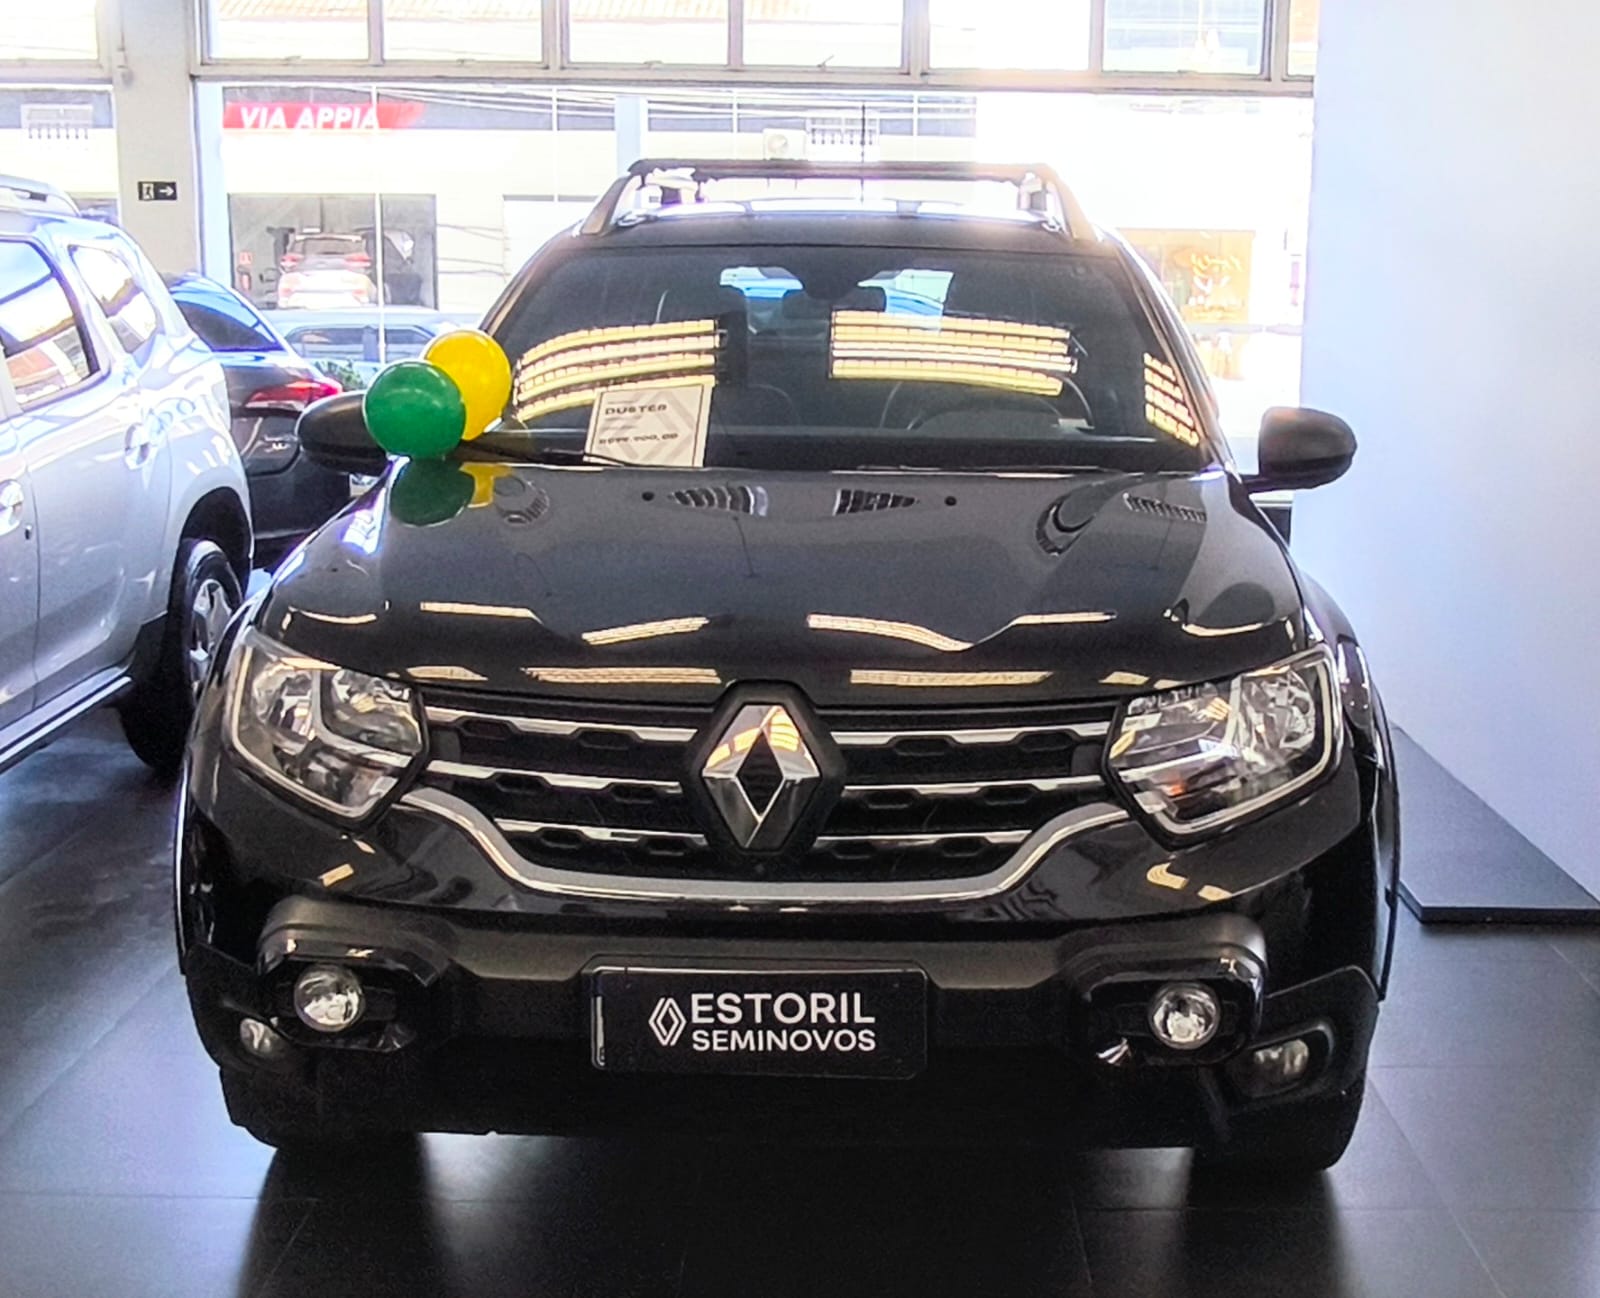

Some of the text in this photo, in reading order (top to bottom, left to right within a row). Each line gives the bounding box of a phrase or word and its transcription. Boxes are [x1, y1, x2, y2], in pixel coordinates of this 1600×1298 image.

[240, 106, 379, 128] VIA APPIA
[605, 404, 667, 415] DUSTER
[691, 992, 876, 1024] ESTORIL
[692, 1029, 876, 1051] SEMINOVOS
